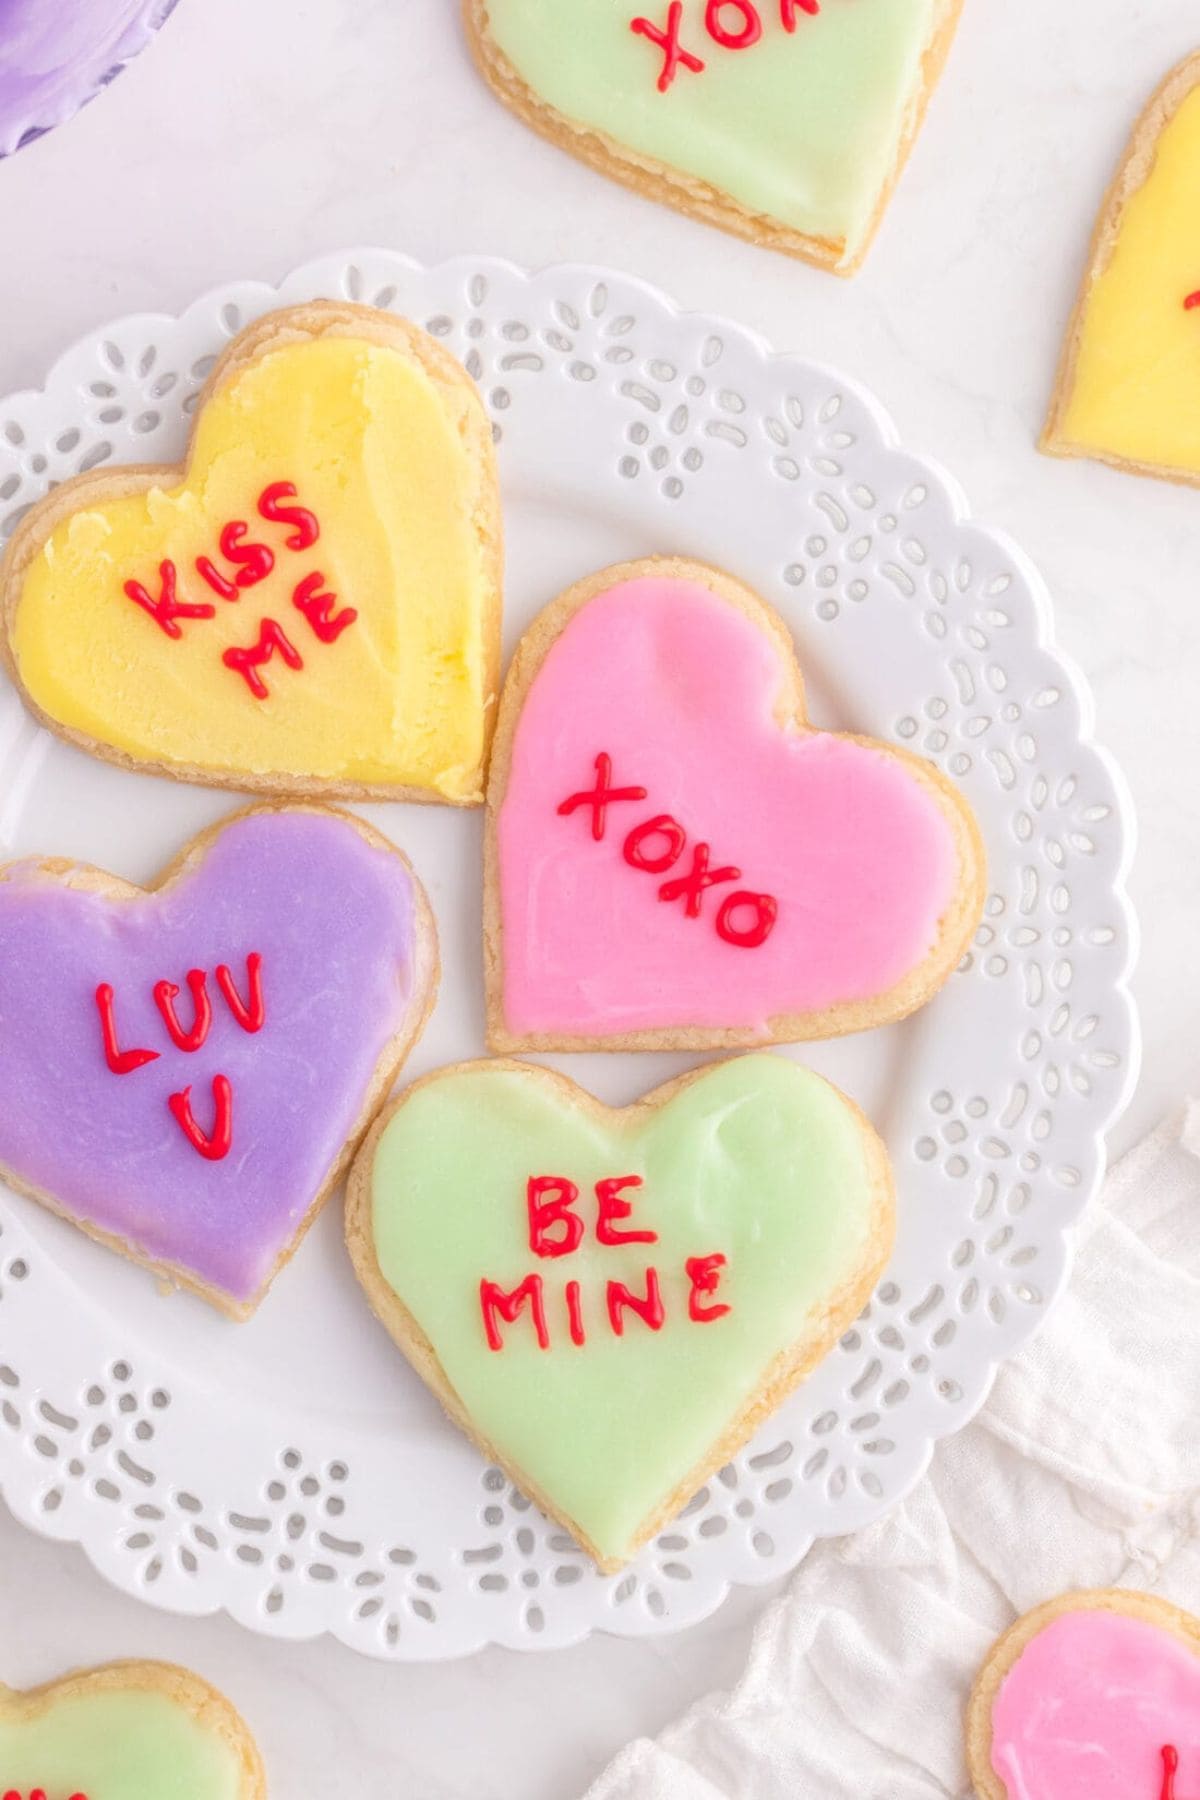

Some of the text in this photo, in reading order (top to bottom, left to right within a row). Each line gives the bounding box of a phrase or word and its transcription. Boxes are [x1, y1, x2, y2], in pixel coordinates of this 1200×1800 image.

[123, 481, 320, 640] KISS
[222, 571, 358, 700] ME
[557, 752, 778, 949] XOXO
[95, 952, 265, 1075] LUV
[527, 1175, 658, 1258] BE
[479, 1253, 731, 1351] MINE
